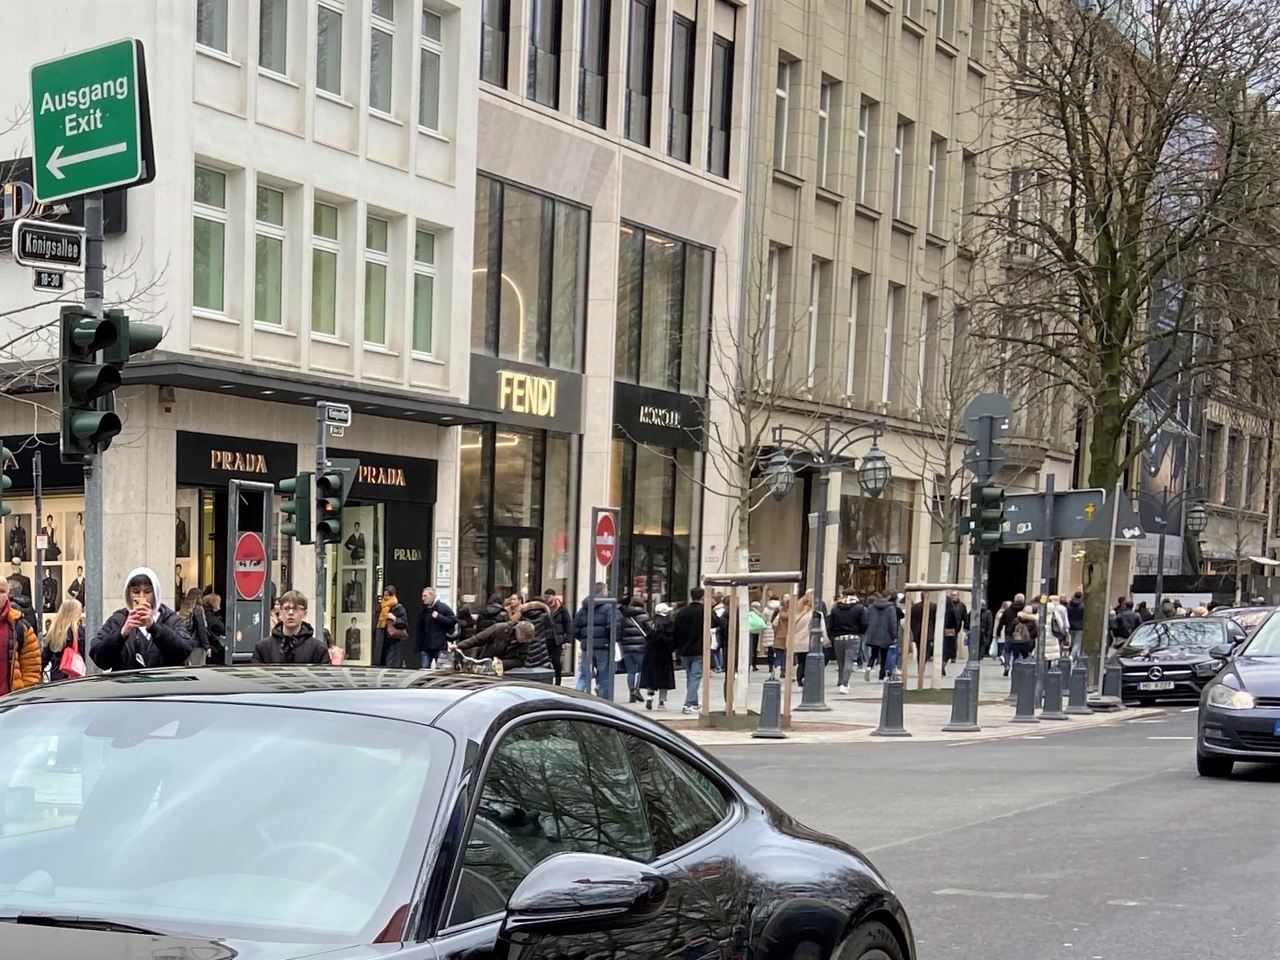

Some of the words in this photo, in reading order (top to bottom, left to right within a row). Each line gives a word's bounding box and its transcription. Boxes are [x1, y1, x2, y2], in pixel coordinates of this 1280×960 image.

[40, 76, 128, 115] Ausgang
[64, 108, 103, 137] Exit
[25, 232, 78, 259] Königsallee
[40, 273, 60, 287] 18-30
[496, 369, 558, 418] FENDI
[210, 449, 268, 474] PRADA
[358, 465, 407, 487] PRADA
[394, 548, 422, 561] PRADA
